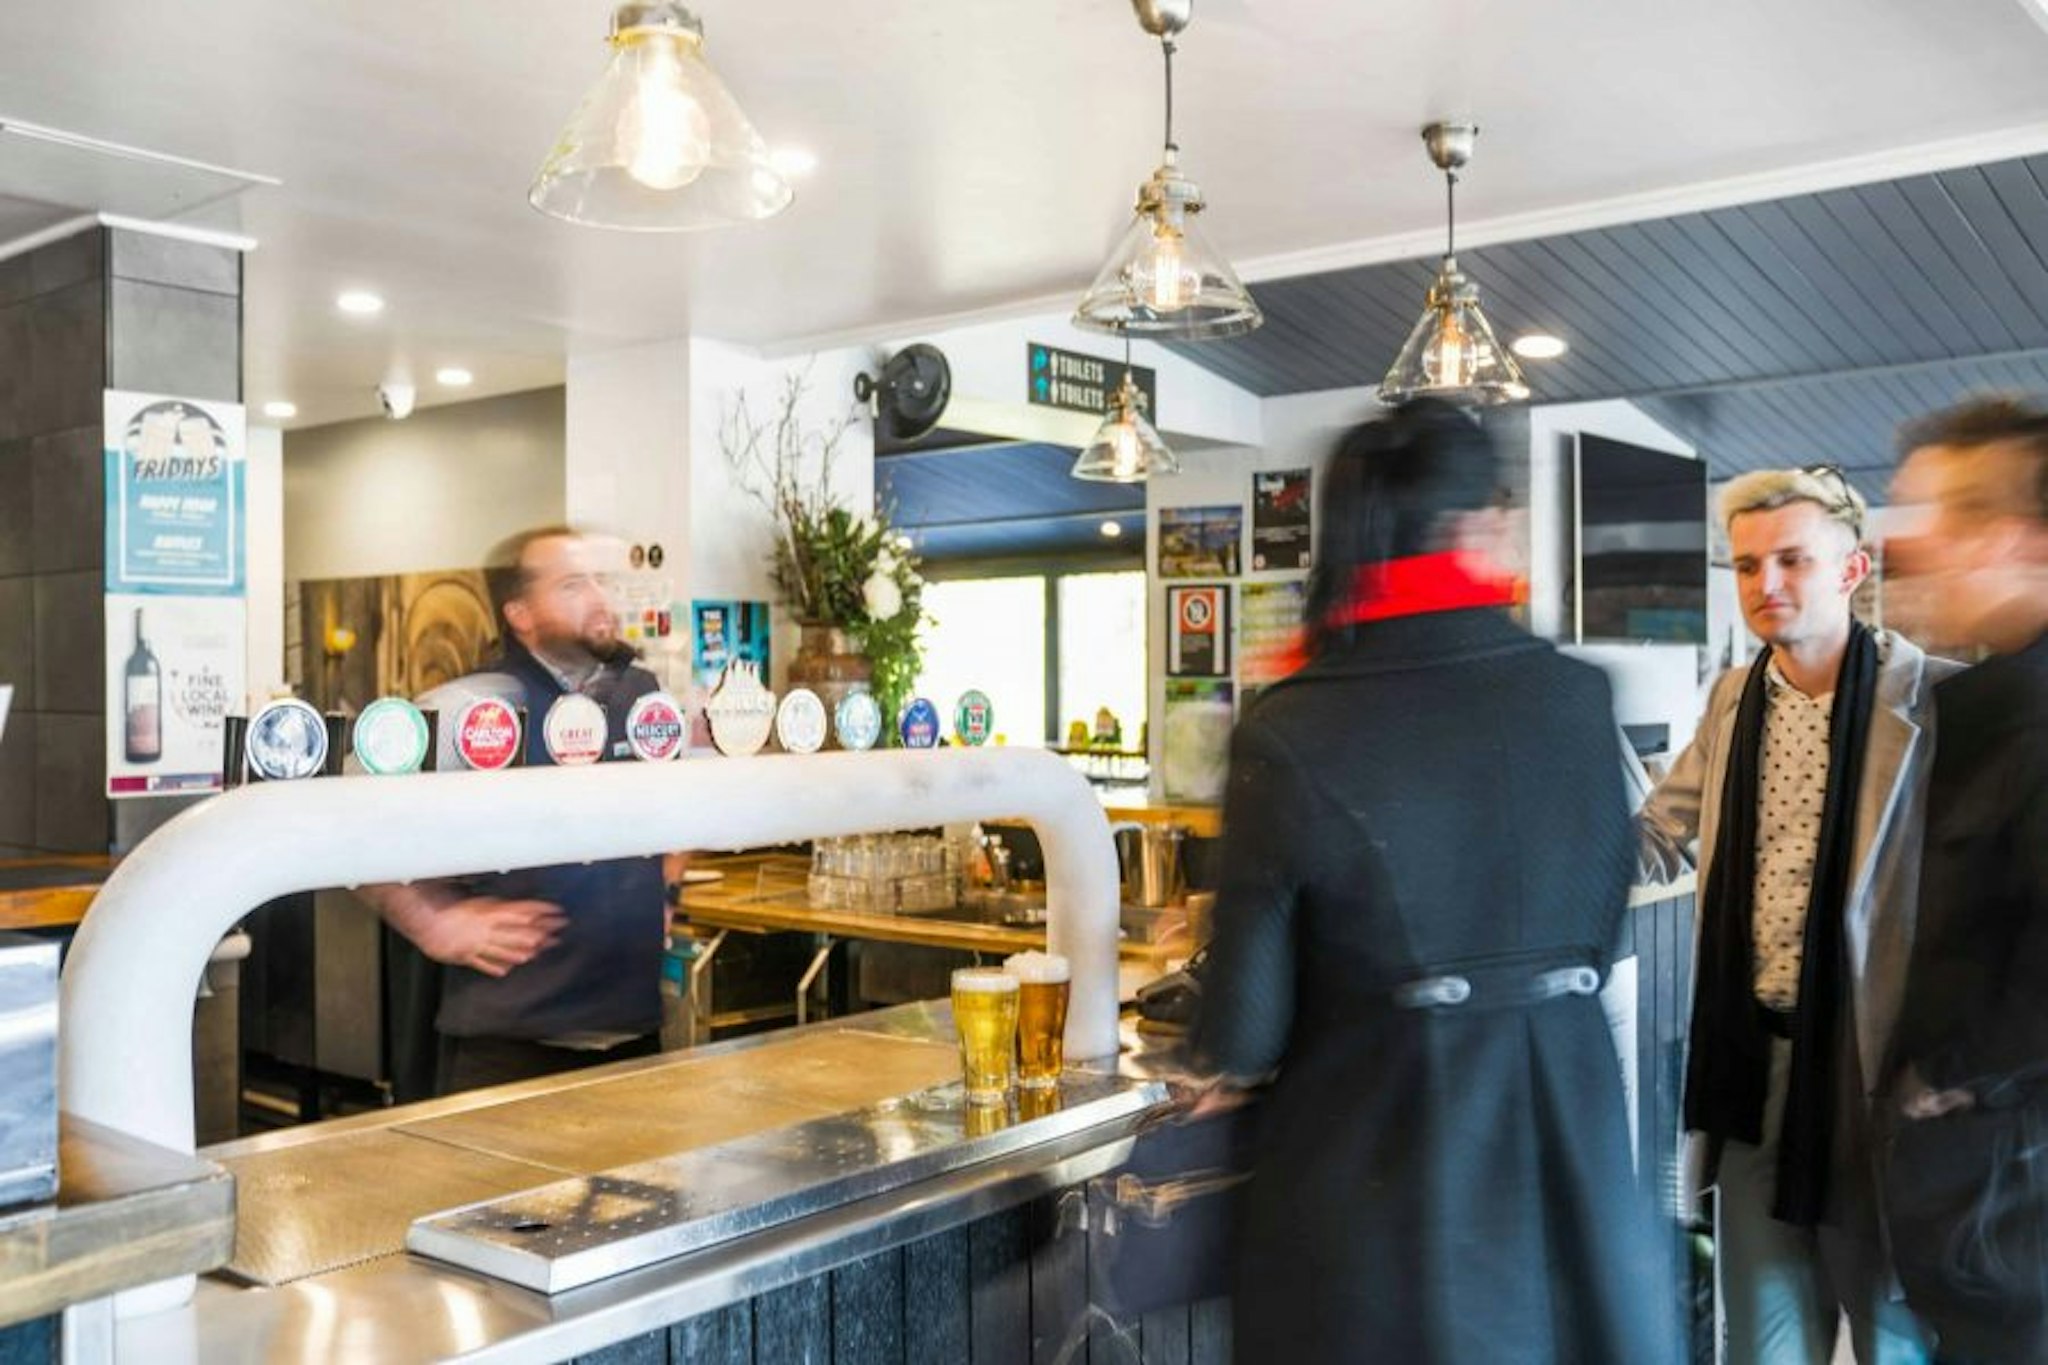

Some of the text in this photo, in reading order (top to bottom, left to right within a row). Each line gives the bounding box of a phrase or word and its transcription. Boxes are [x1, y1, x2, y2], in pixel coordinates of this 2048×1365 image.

[1060, 354, 1104, 383] TOILETS
[1060, 381, 1104, 410] TOILETS
[134, 455, 220, 480] FRIDAYS
[188, 674, 223, 687] FINE
[181, 688, 229, 703] LOCAL
[187, 704, 224, 718] WINE
[635, 723, 680, 738] MERCURY
